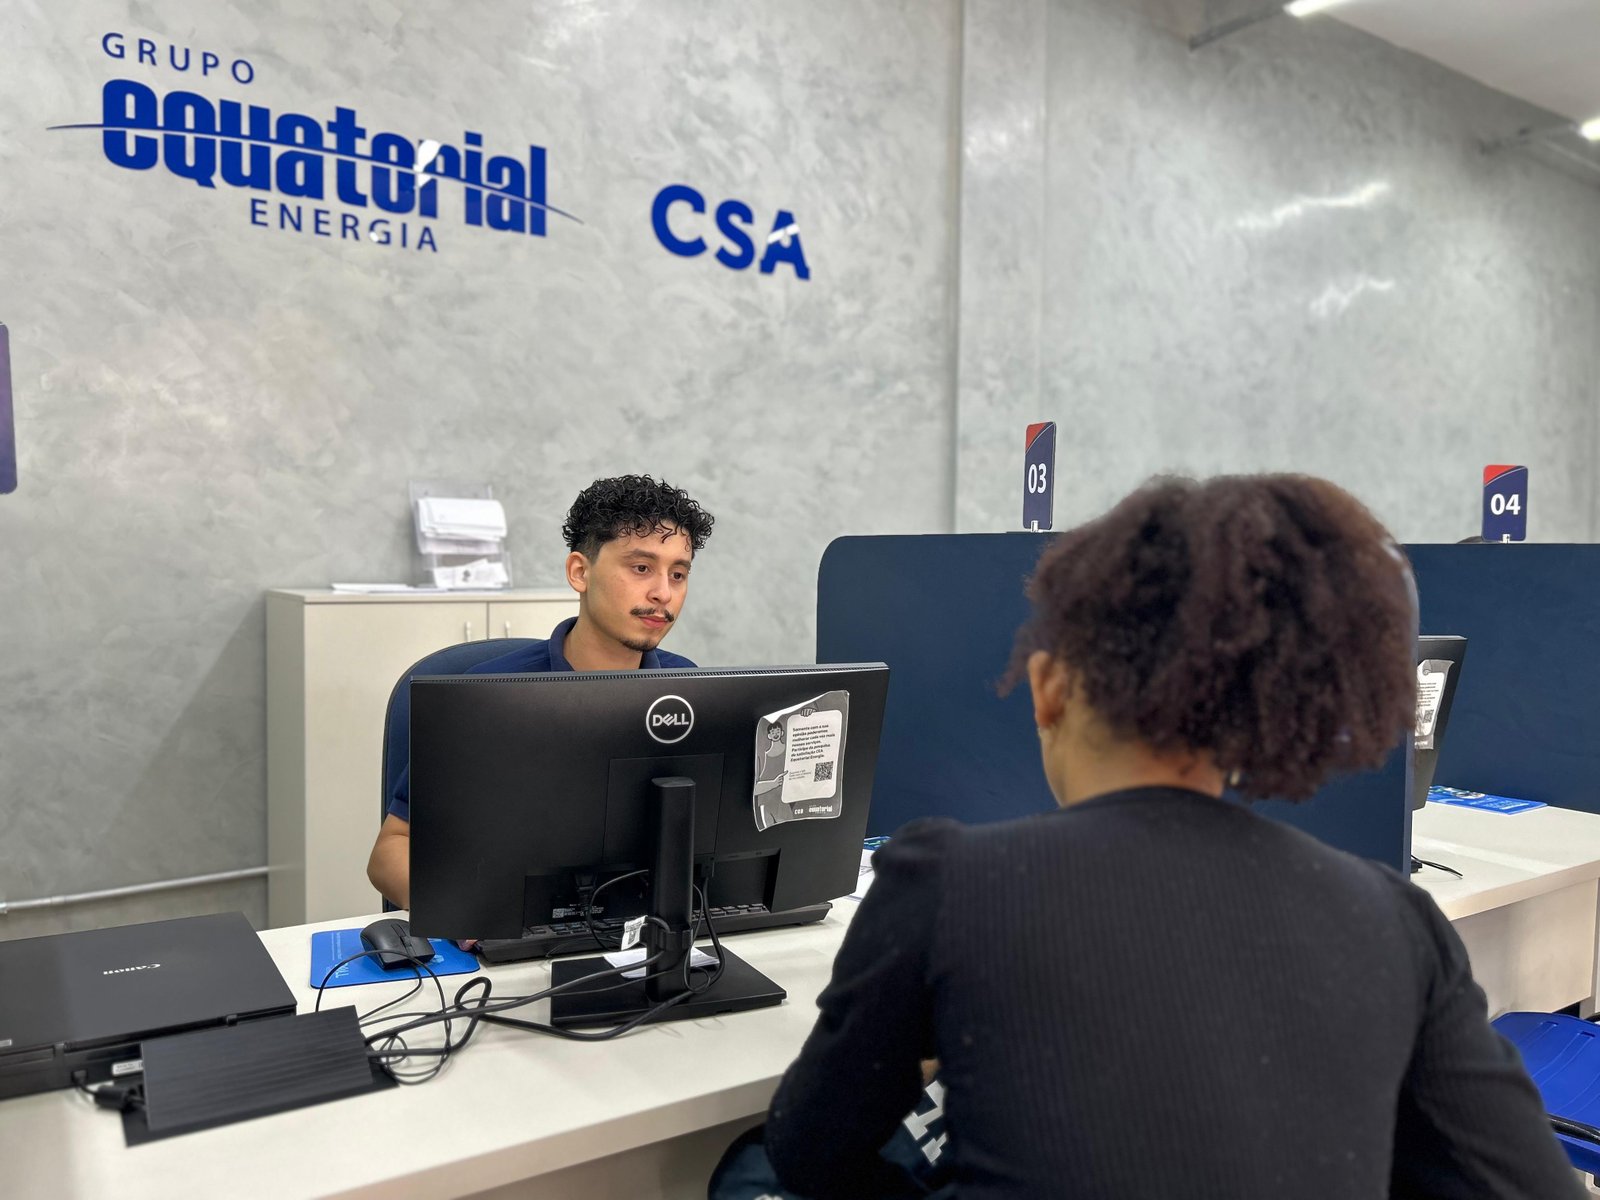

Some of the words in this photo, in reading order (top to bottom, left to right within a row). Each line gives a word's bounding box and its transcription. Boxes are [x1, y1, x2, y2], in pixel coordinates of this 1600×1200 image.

[102, 33, 254, 84] GRUPO
[250, 198, 438, 253] ENERGIA
[651, 184, 810, 281] CSA
[1028, 463, 1047, 494] 03
[1490, 493, 1521, 515] 04
[652, 713, 689, 727] DELL
